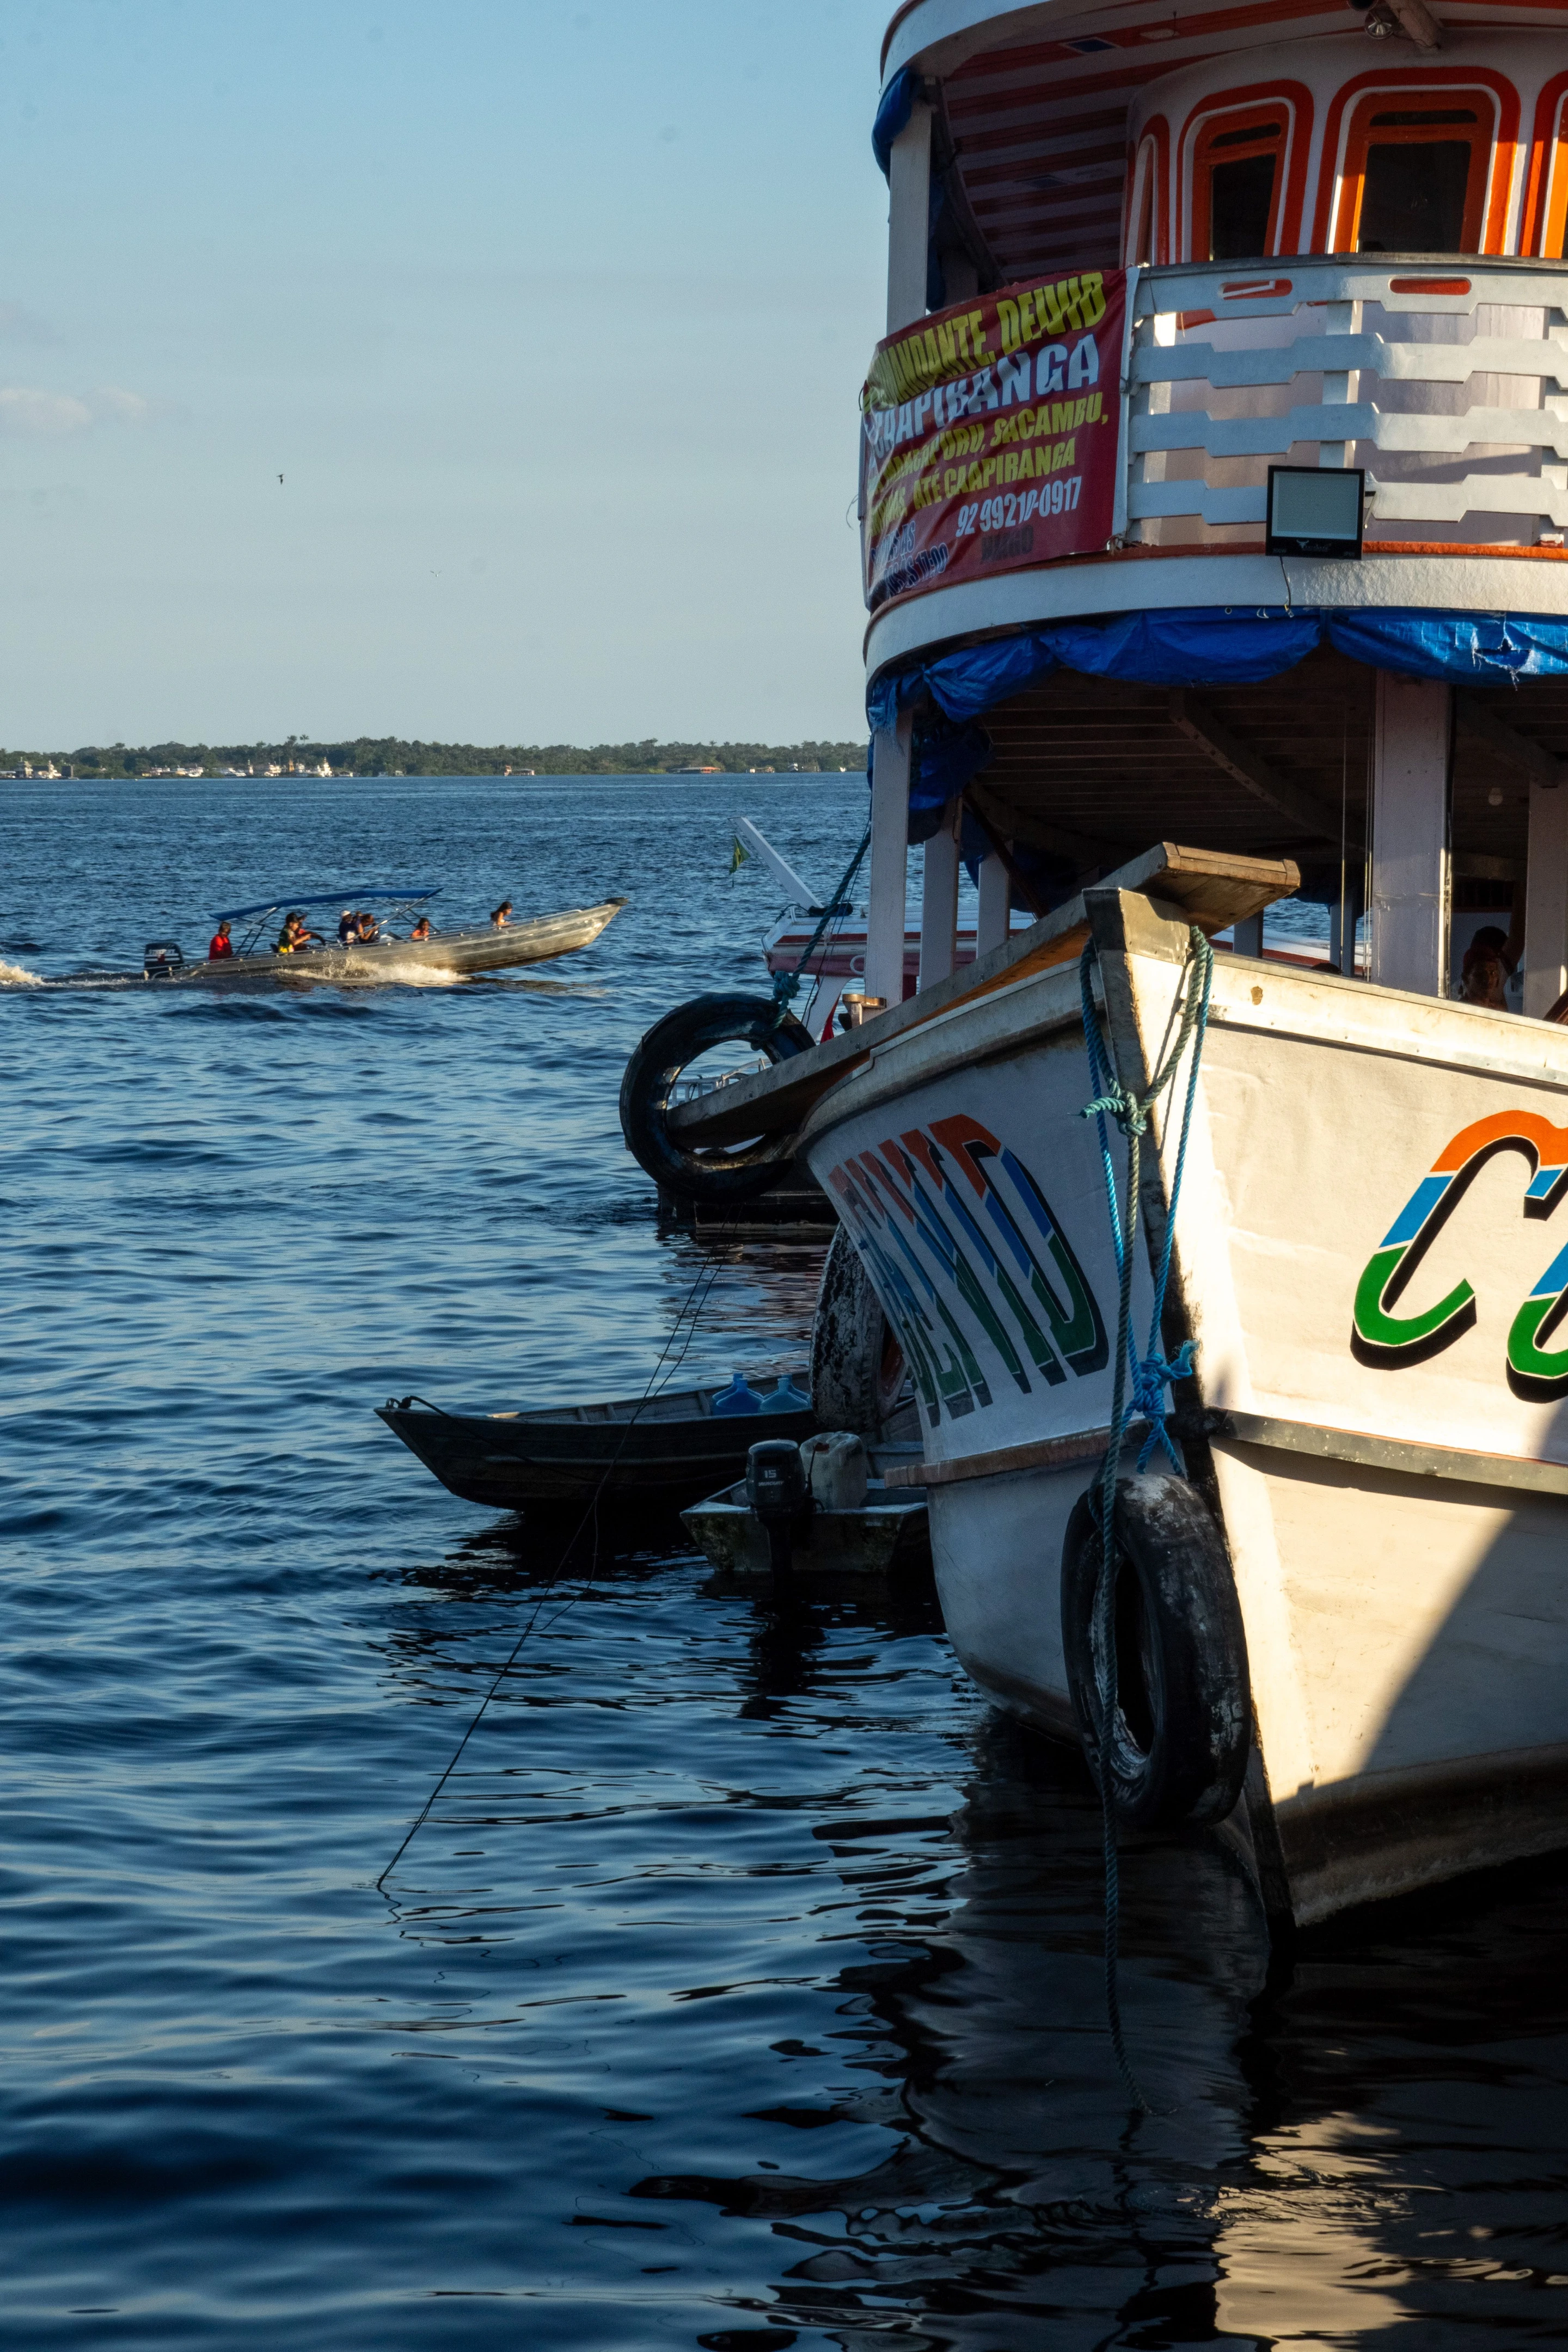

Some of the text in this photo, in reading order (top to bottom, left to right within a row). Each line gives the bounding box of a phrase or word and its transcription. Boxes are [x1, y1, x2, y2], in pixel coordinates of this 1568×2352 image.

[997, 272, 1107, 356] DEIVID
[990, 391, 1108, 448] SACAMBU,
[912, 438, 1076, 511] ATÉ CAAPIRANGA
[955, 500, 979, 537] 92
[764, 1469, 777, 1478] 15
